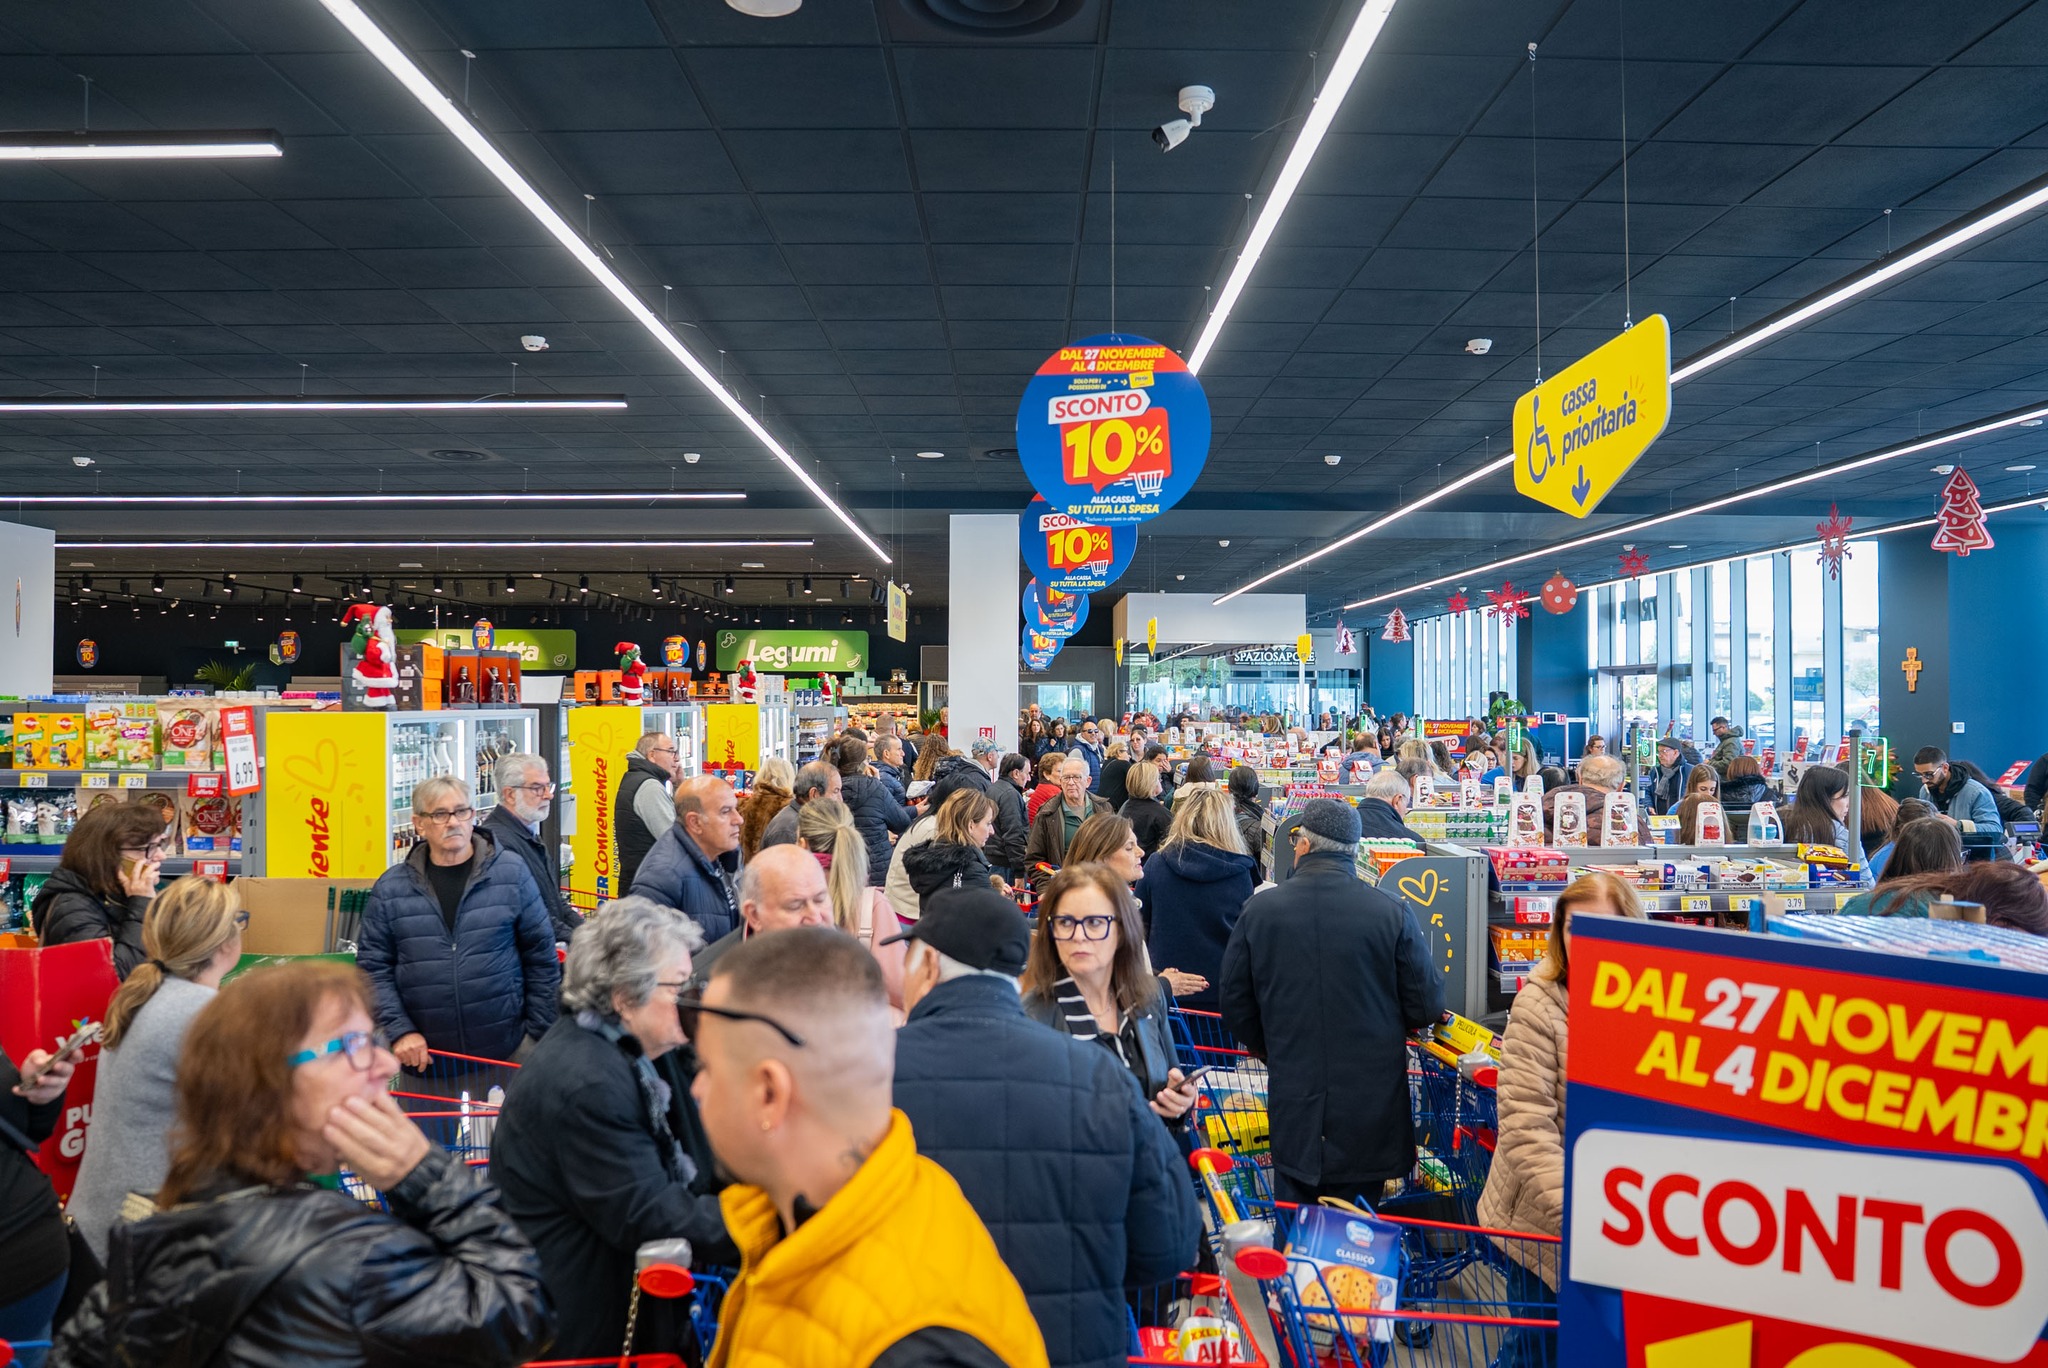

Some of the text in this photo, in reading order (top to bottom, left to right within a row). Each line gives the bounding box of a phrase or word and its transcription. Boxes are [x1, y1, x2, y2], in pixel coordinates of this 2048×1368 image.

[1060, 347, 1166, 360] DAL 27 NOVEMBRE
[1070, 360, 1155, 372] AL 4 DICEMBRE
[1561, 378, 1597, 416] cassa
[1055, 393, 1142, 419] SCONTO
[1562, 390, 1637, 466] prioritaria
[1065, 419, 1163, 478] 10%
[1090, 496, 1136, 504] ALLA CASSA
[1068, 504, 1160, 514] SU TUTTA LA SPESA
[1043, 516, 1083, 528] SCON
[1050, 528, 1109, 565] 10%
[746, 640, 838, 668] Legumi
[1234, 652, 1315, 662] SPAZIOSAPOE
[172, 727, 194, 736] ONE
[1867, 750, 1876, 774] 7
[31, 777, 45, 786] 2.79
[92, 777, 106, 786] 3.75
[129, 777, 143, 786] 2.79
[197, 813, 220, 822] ONE
[592, 757, 609, 876] Conveniente
[1662, 818, 1677, 827] 3.99
[1532, 902, 1547, 911] 0.89
[1643, 900, 1656, 910] .69
[1693, 900, 1708, 909] 2.99
[1787, 898, 1802, 908] 3.79
[1590, 960, 1696, 1022] DAL
[1699, 977, 1780, 1034] 27
[1456, 1020, 1478, 1036] PELLICOLA
[1634, 1030, 1710, 1088] AL
[1712, 1044, 1757, 1096] 4
[1601, 1165, 2025, 1308] SCONTO
[1336, 1248, 1375, 1265] CLASSICO
[1192, 1328, 1211, 1340] XXL
